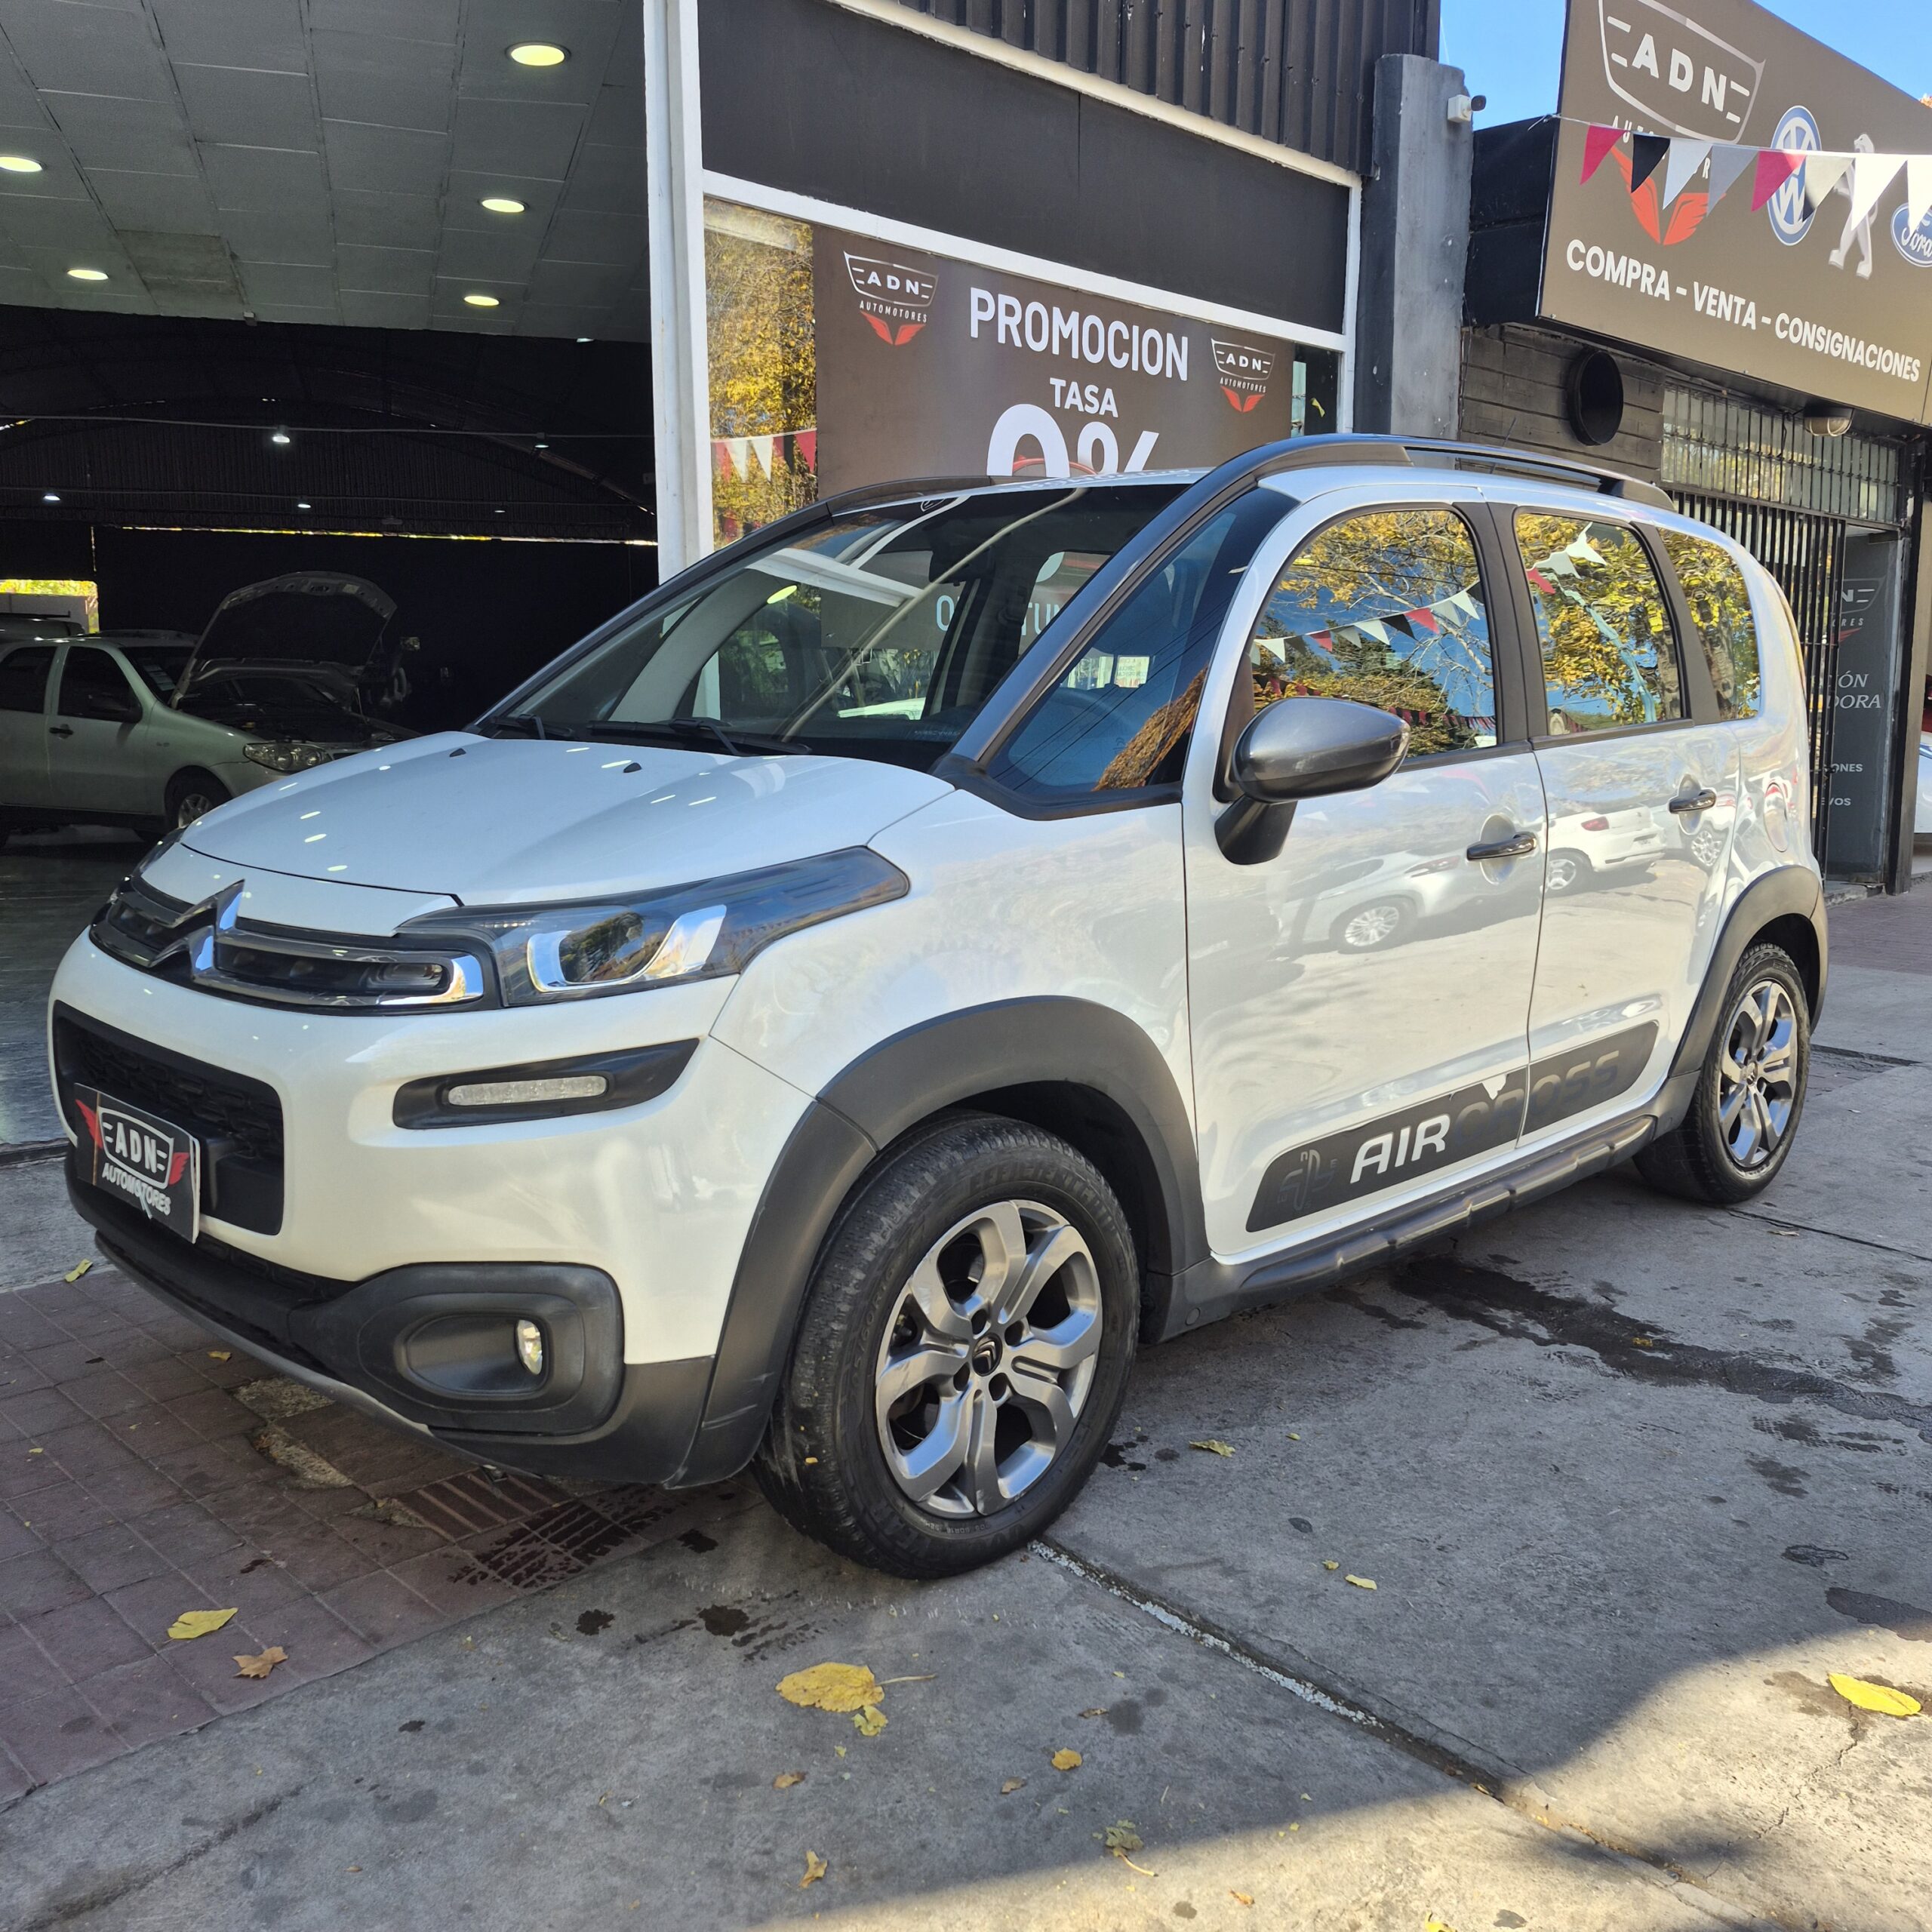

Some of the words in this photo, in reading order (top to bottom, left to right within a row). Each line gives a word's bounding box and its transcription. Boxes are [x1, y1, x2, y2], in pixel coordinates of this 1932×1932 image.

[1632, 32, 1727, 112] ADN
[867, 271, 920, 295] ADN
[859, 300, 928, 323] AUTOMOTORES
[970, 287, 1189, 381] PROMOCION
[1566, 239, 1671, 302] COMPRA
[1694, 281, 1757, 330] VENTA
[1775, 312, 1921, 383] CONSIGNACIONES
[1220, 377, 1266, 393] AUTOMOTORES
[1226, 353, 1262, 371] ADN
[1050, 377, 1118, 417] TASA
[115, 1122, 157, 1174] ADN
[101, 1162, 171, 1216] AUTOMOTORES
